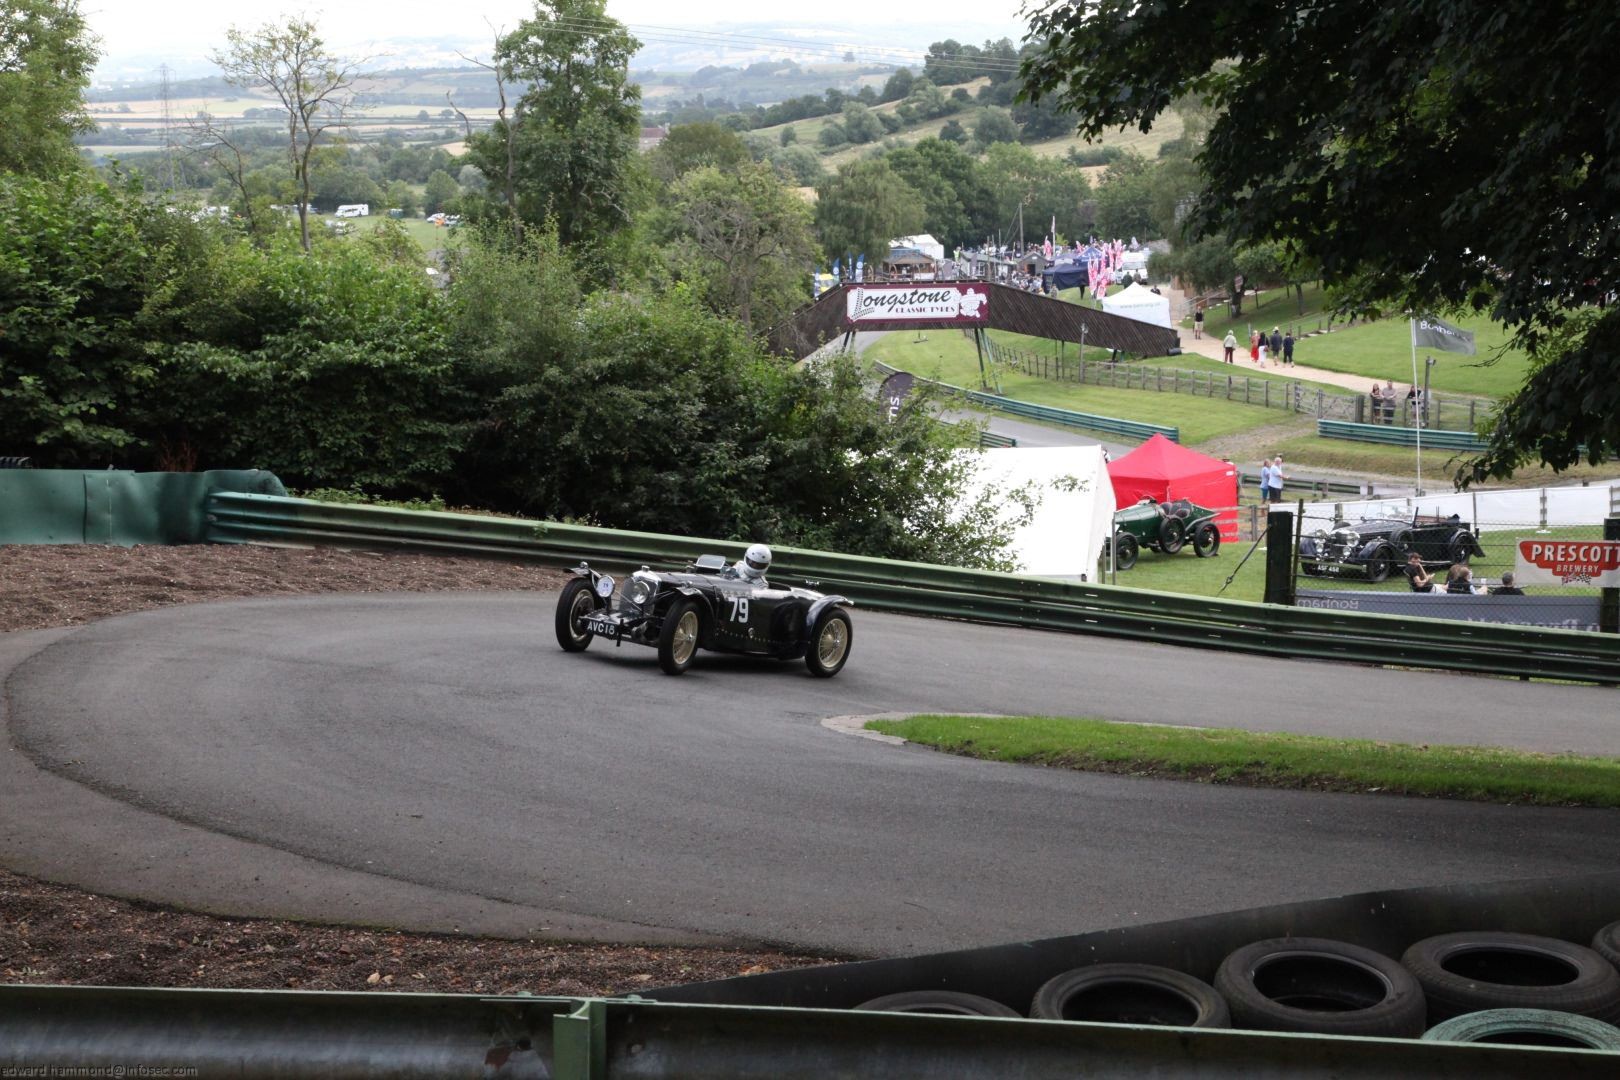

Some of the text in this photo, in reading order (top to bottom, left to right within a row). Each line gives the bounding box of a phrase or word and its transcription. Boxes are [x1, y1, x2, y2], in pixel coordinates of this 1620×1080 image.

[851, 287, 951, 320] Longstone
[1556, 564, 1599, 573] BREWERY
[728, 597, 748, 623] 79
